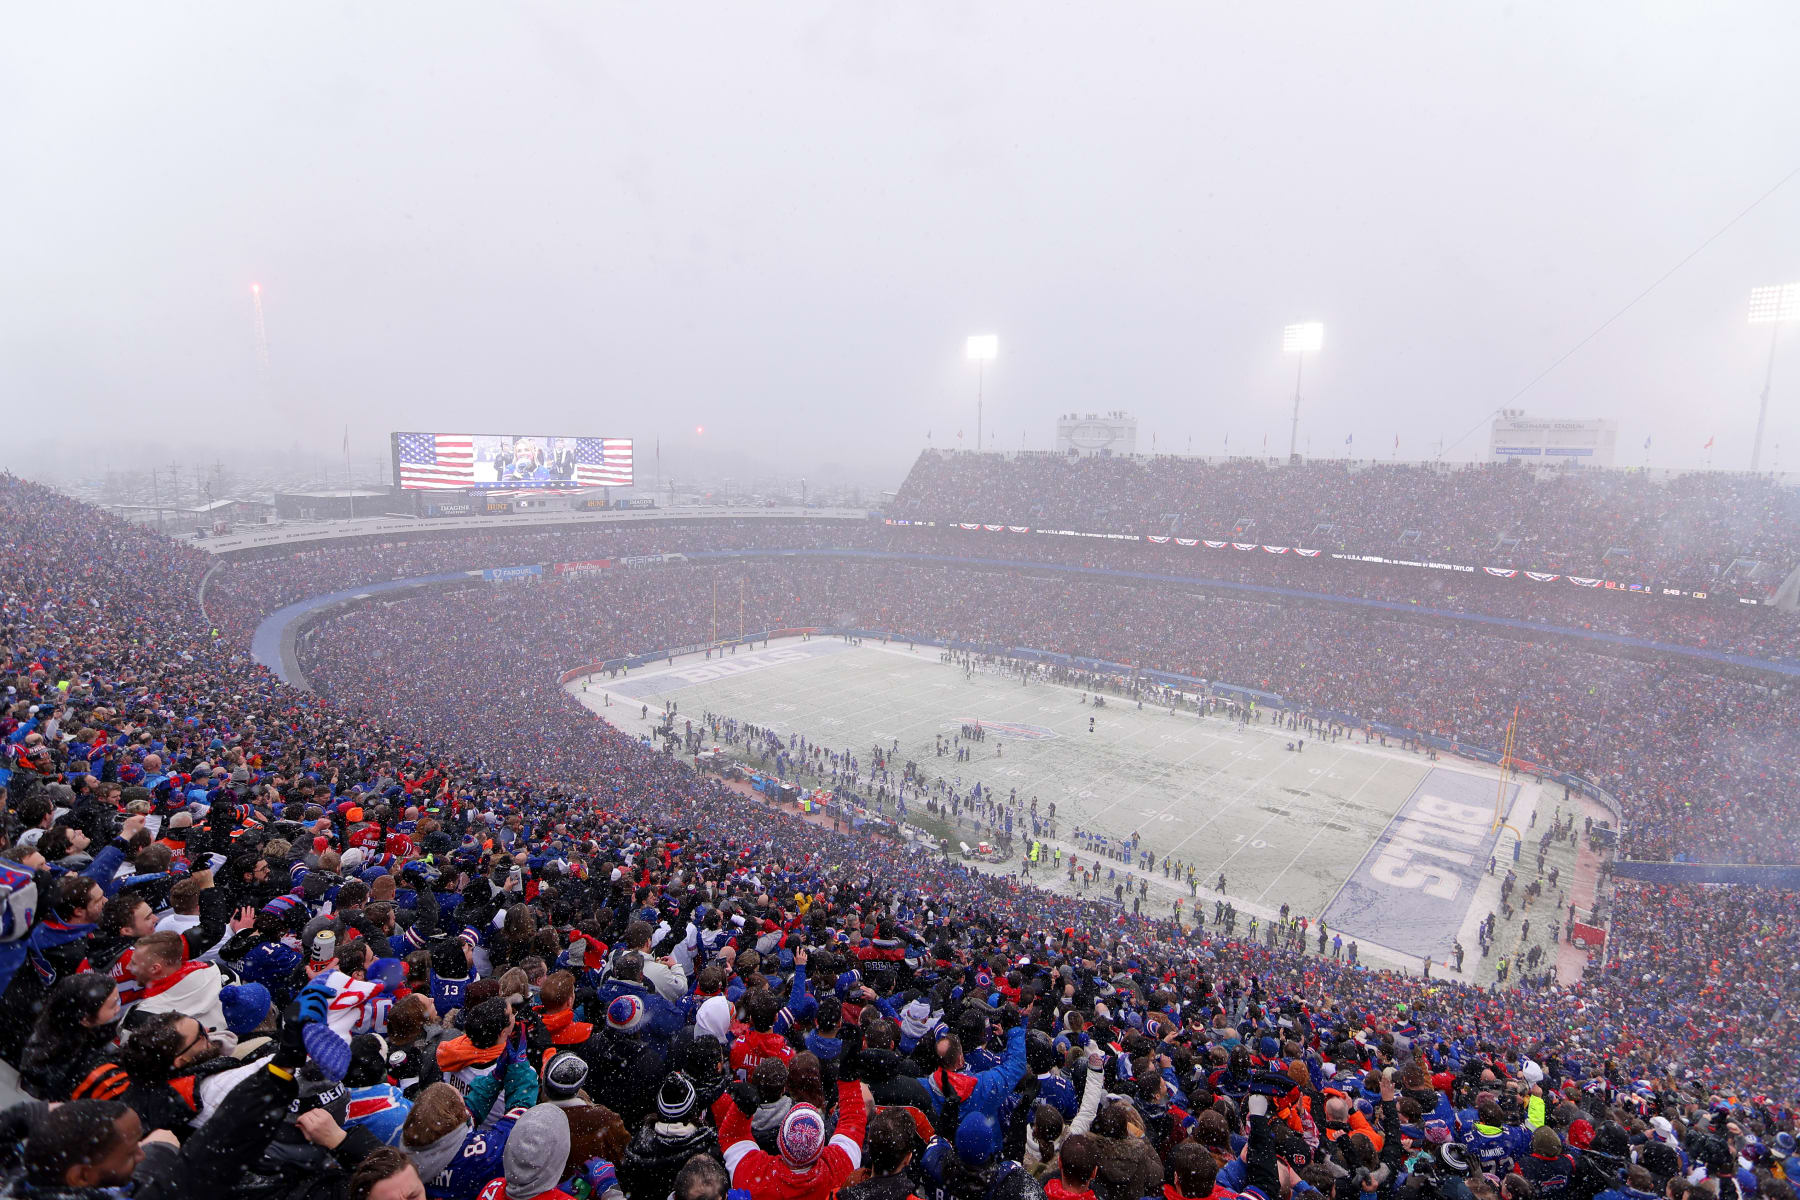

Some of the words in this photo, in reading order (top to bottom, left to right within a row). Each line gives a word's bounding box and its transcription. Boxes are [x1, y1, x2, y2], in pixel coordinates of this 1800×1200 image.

[487, 503, 508, 511] HUNT
[1362, 555, 1383, 563] ANTHEM
[1232, 834, 1268, 850] 10
[1370, 794, 1496, 902] BILLS
[444, 984, 459, 996] 13
[1480, 1146, 1505, 1158] DAWKINS
